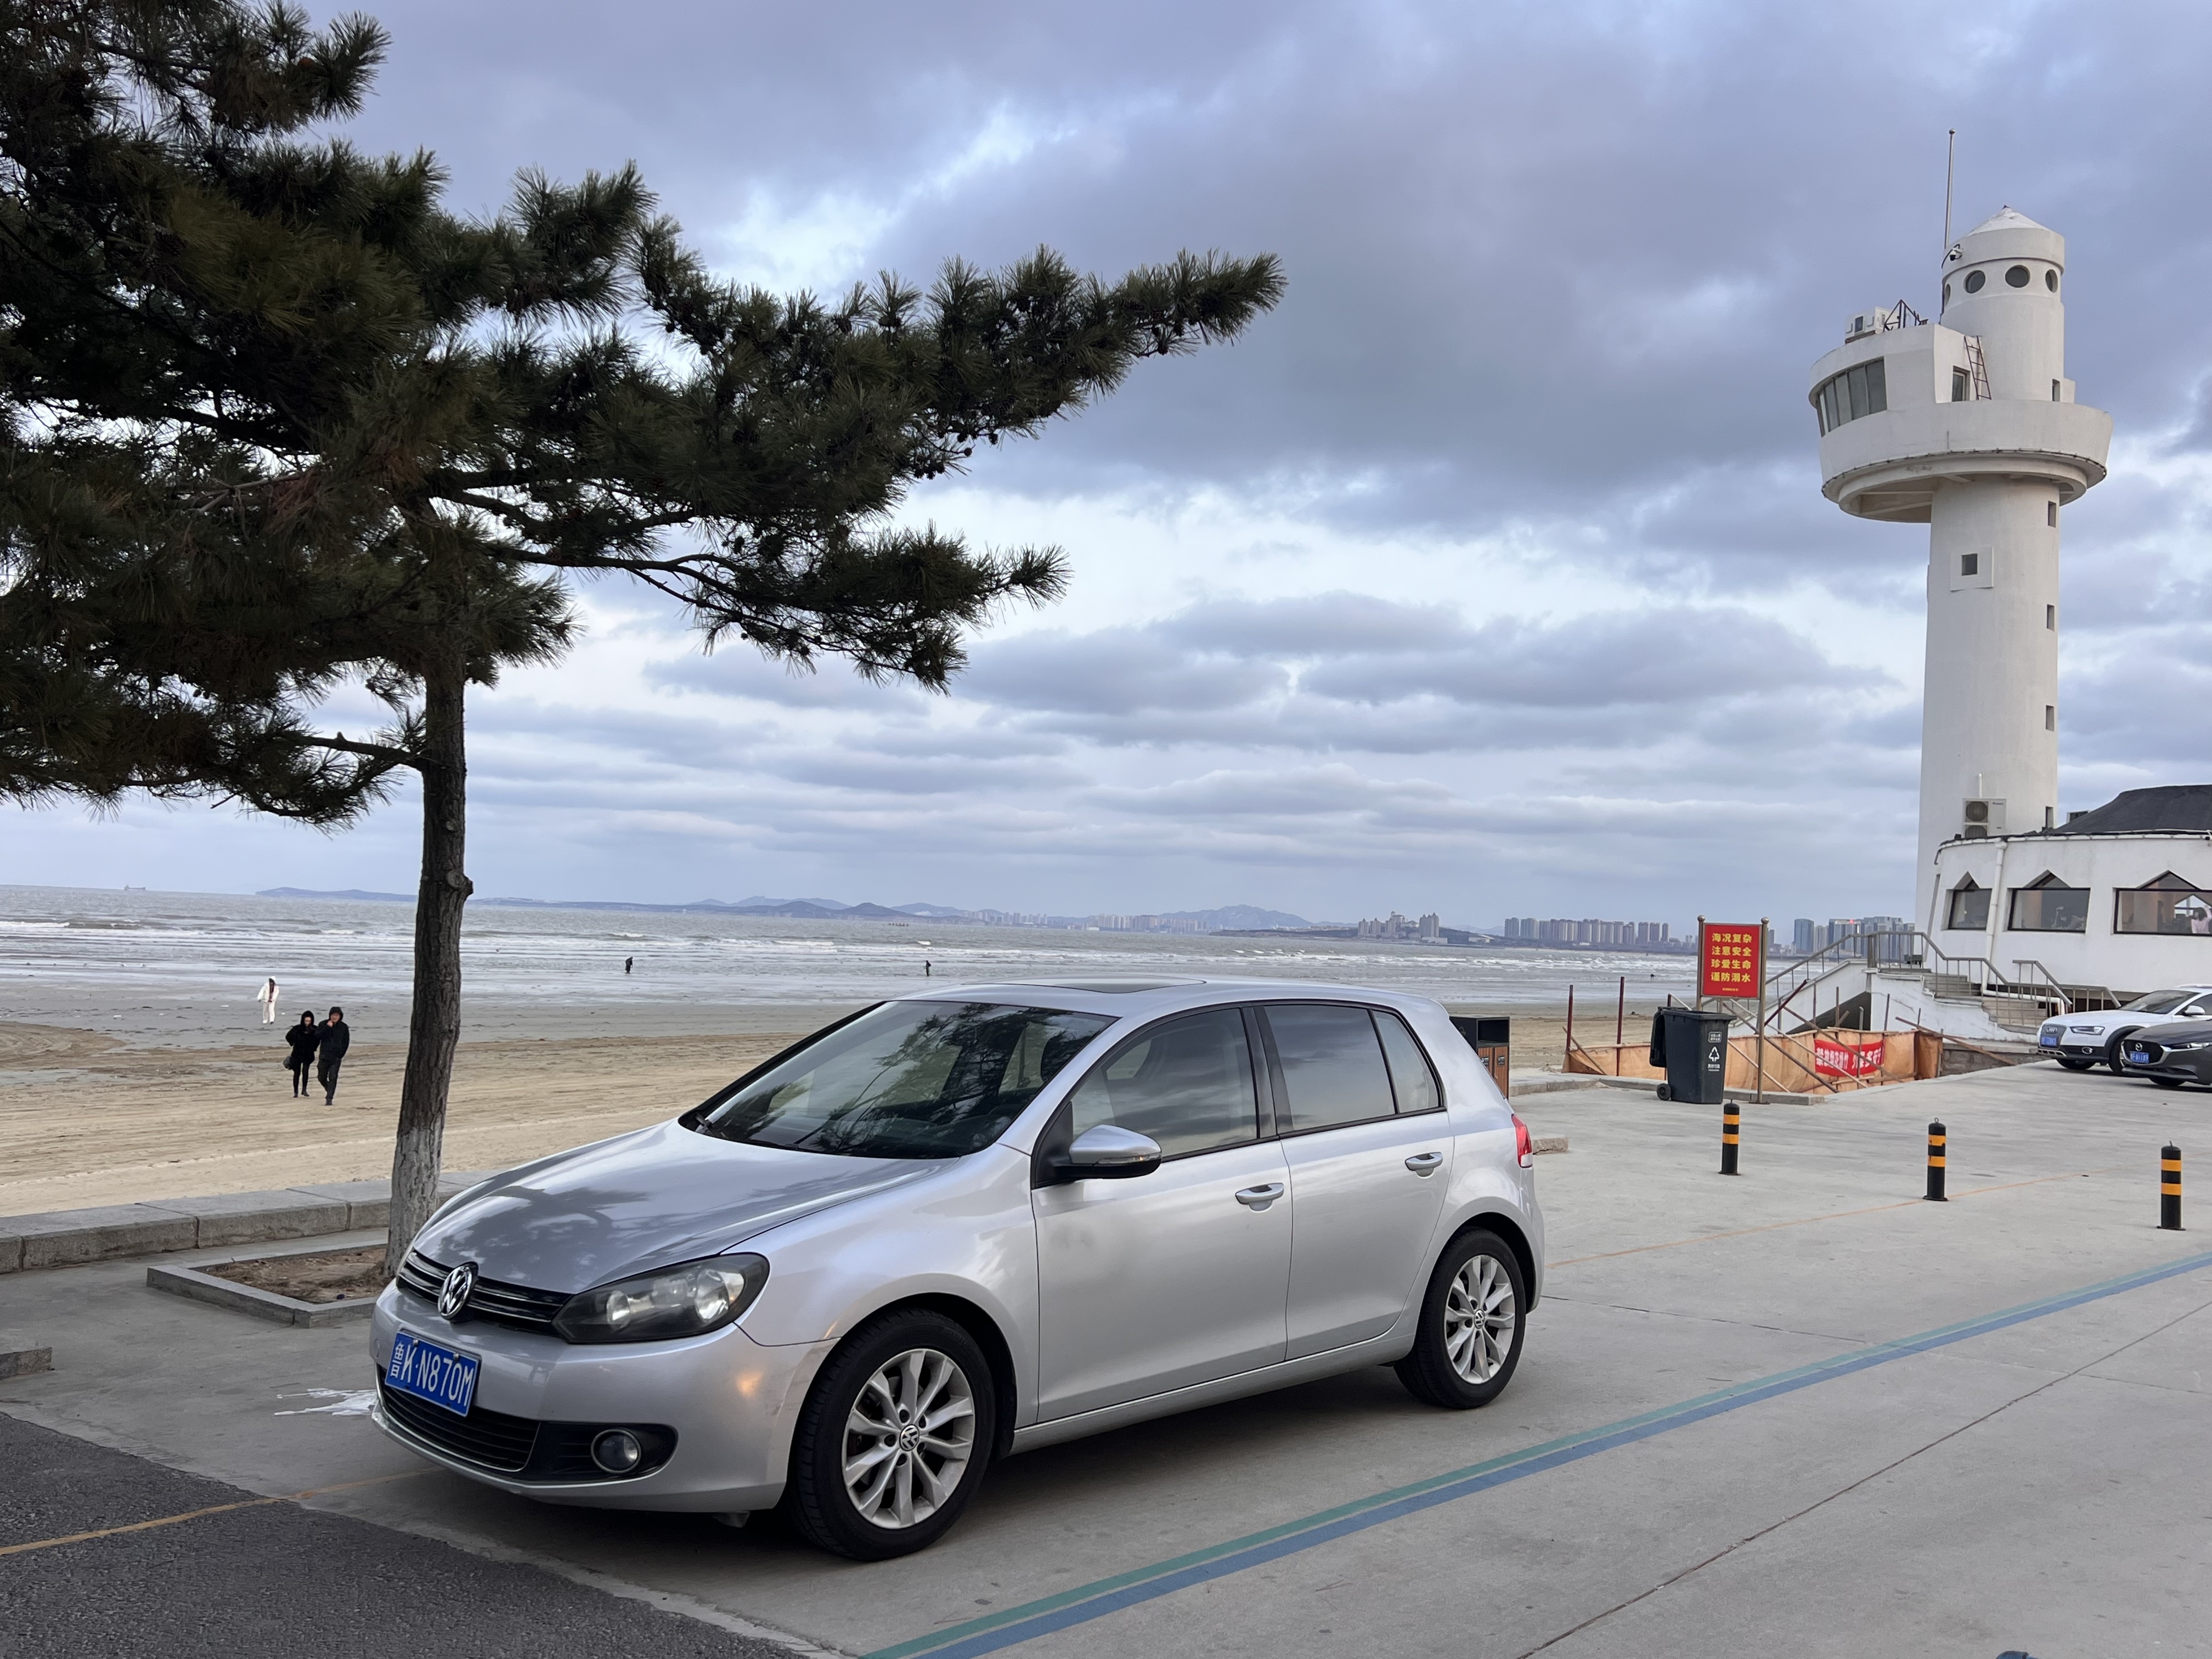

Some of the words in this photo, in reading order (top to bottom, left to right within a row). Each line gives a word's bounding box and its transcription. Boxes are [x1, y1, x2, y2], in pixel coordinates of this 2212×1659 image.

[1712, 933, 1752, 943] 海况复杂
[1712, 946, 1752, 956] 注意安全
[1711, 959, 1752, 969] 珍爱生命
[1711, 972, 1751, 983] 谨防溺水
